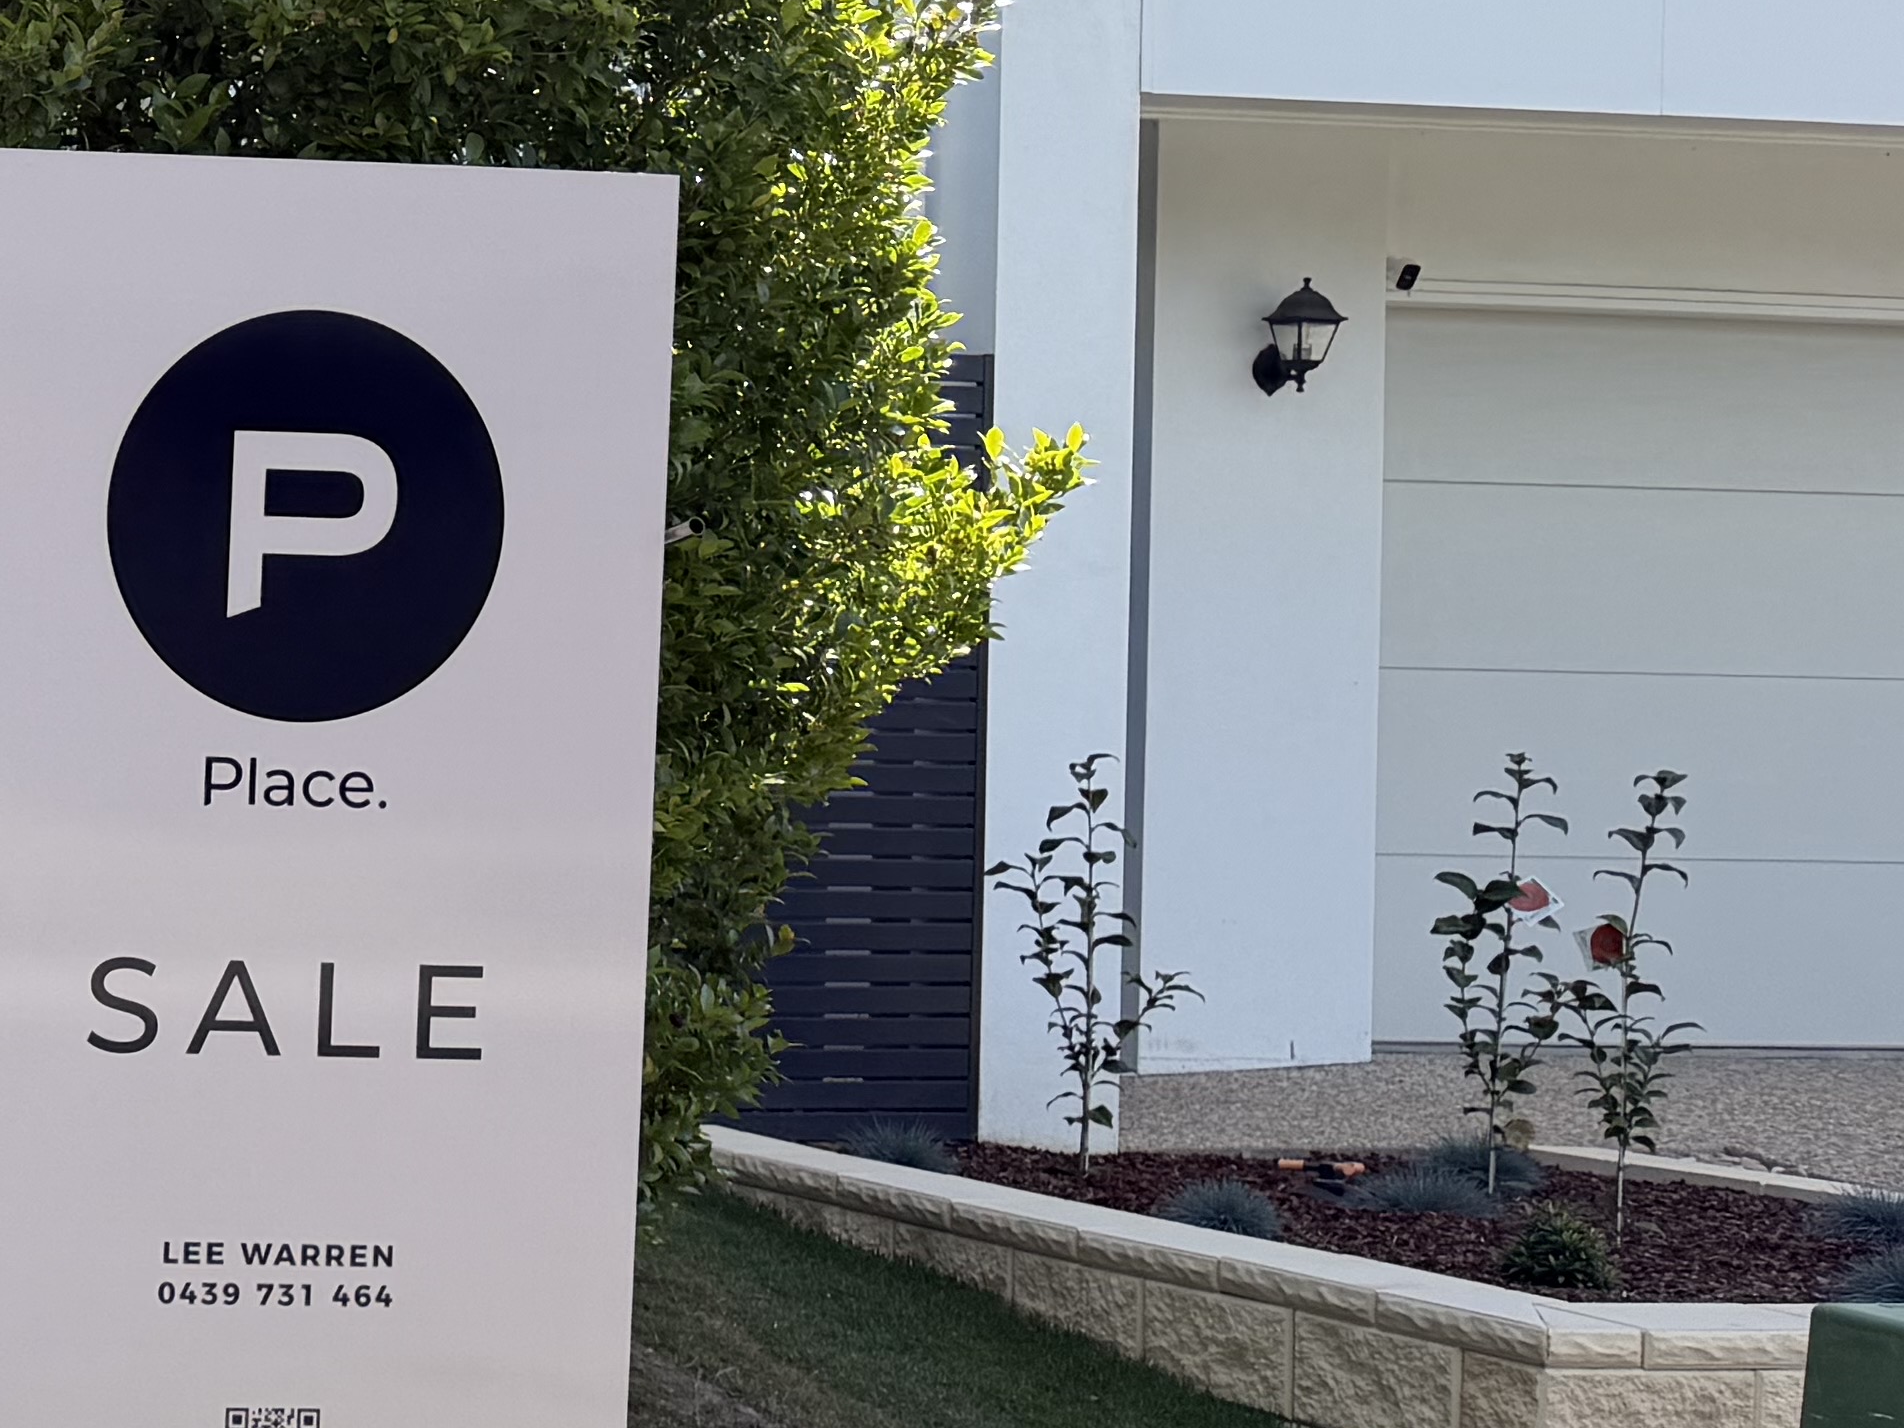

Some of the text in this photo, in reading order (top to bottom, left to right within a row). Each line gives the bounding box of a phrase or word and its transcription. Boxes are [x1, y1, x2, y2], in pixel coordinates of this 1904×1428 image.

[226, 430, 398, 618] P
[203, 756, 387, 810] Place.
[86, 956, 484, 1061] SALE
[163, 1241, 394, 1268] LEE WARREN
[157, 1281, 393, 1308] 0439 731 464
